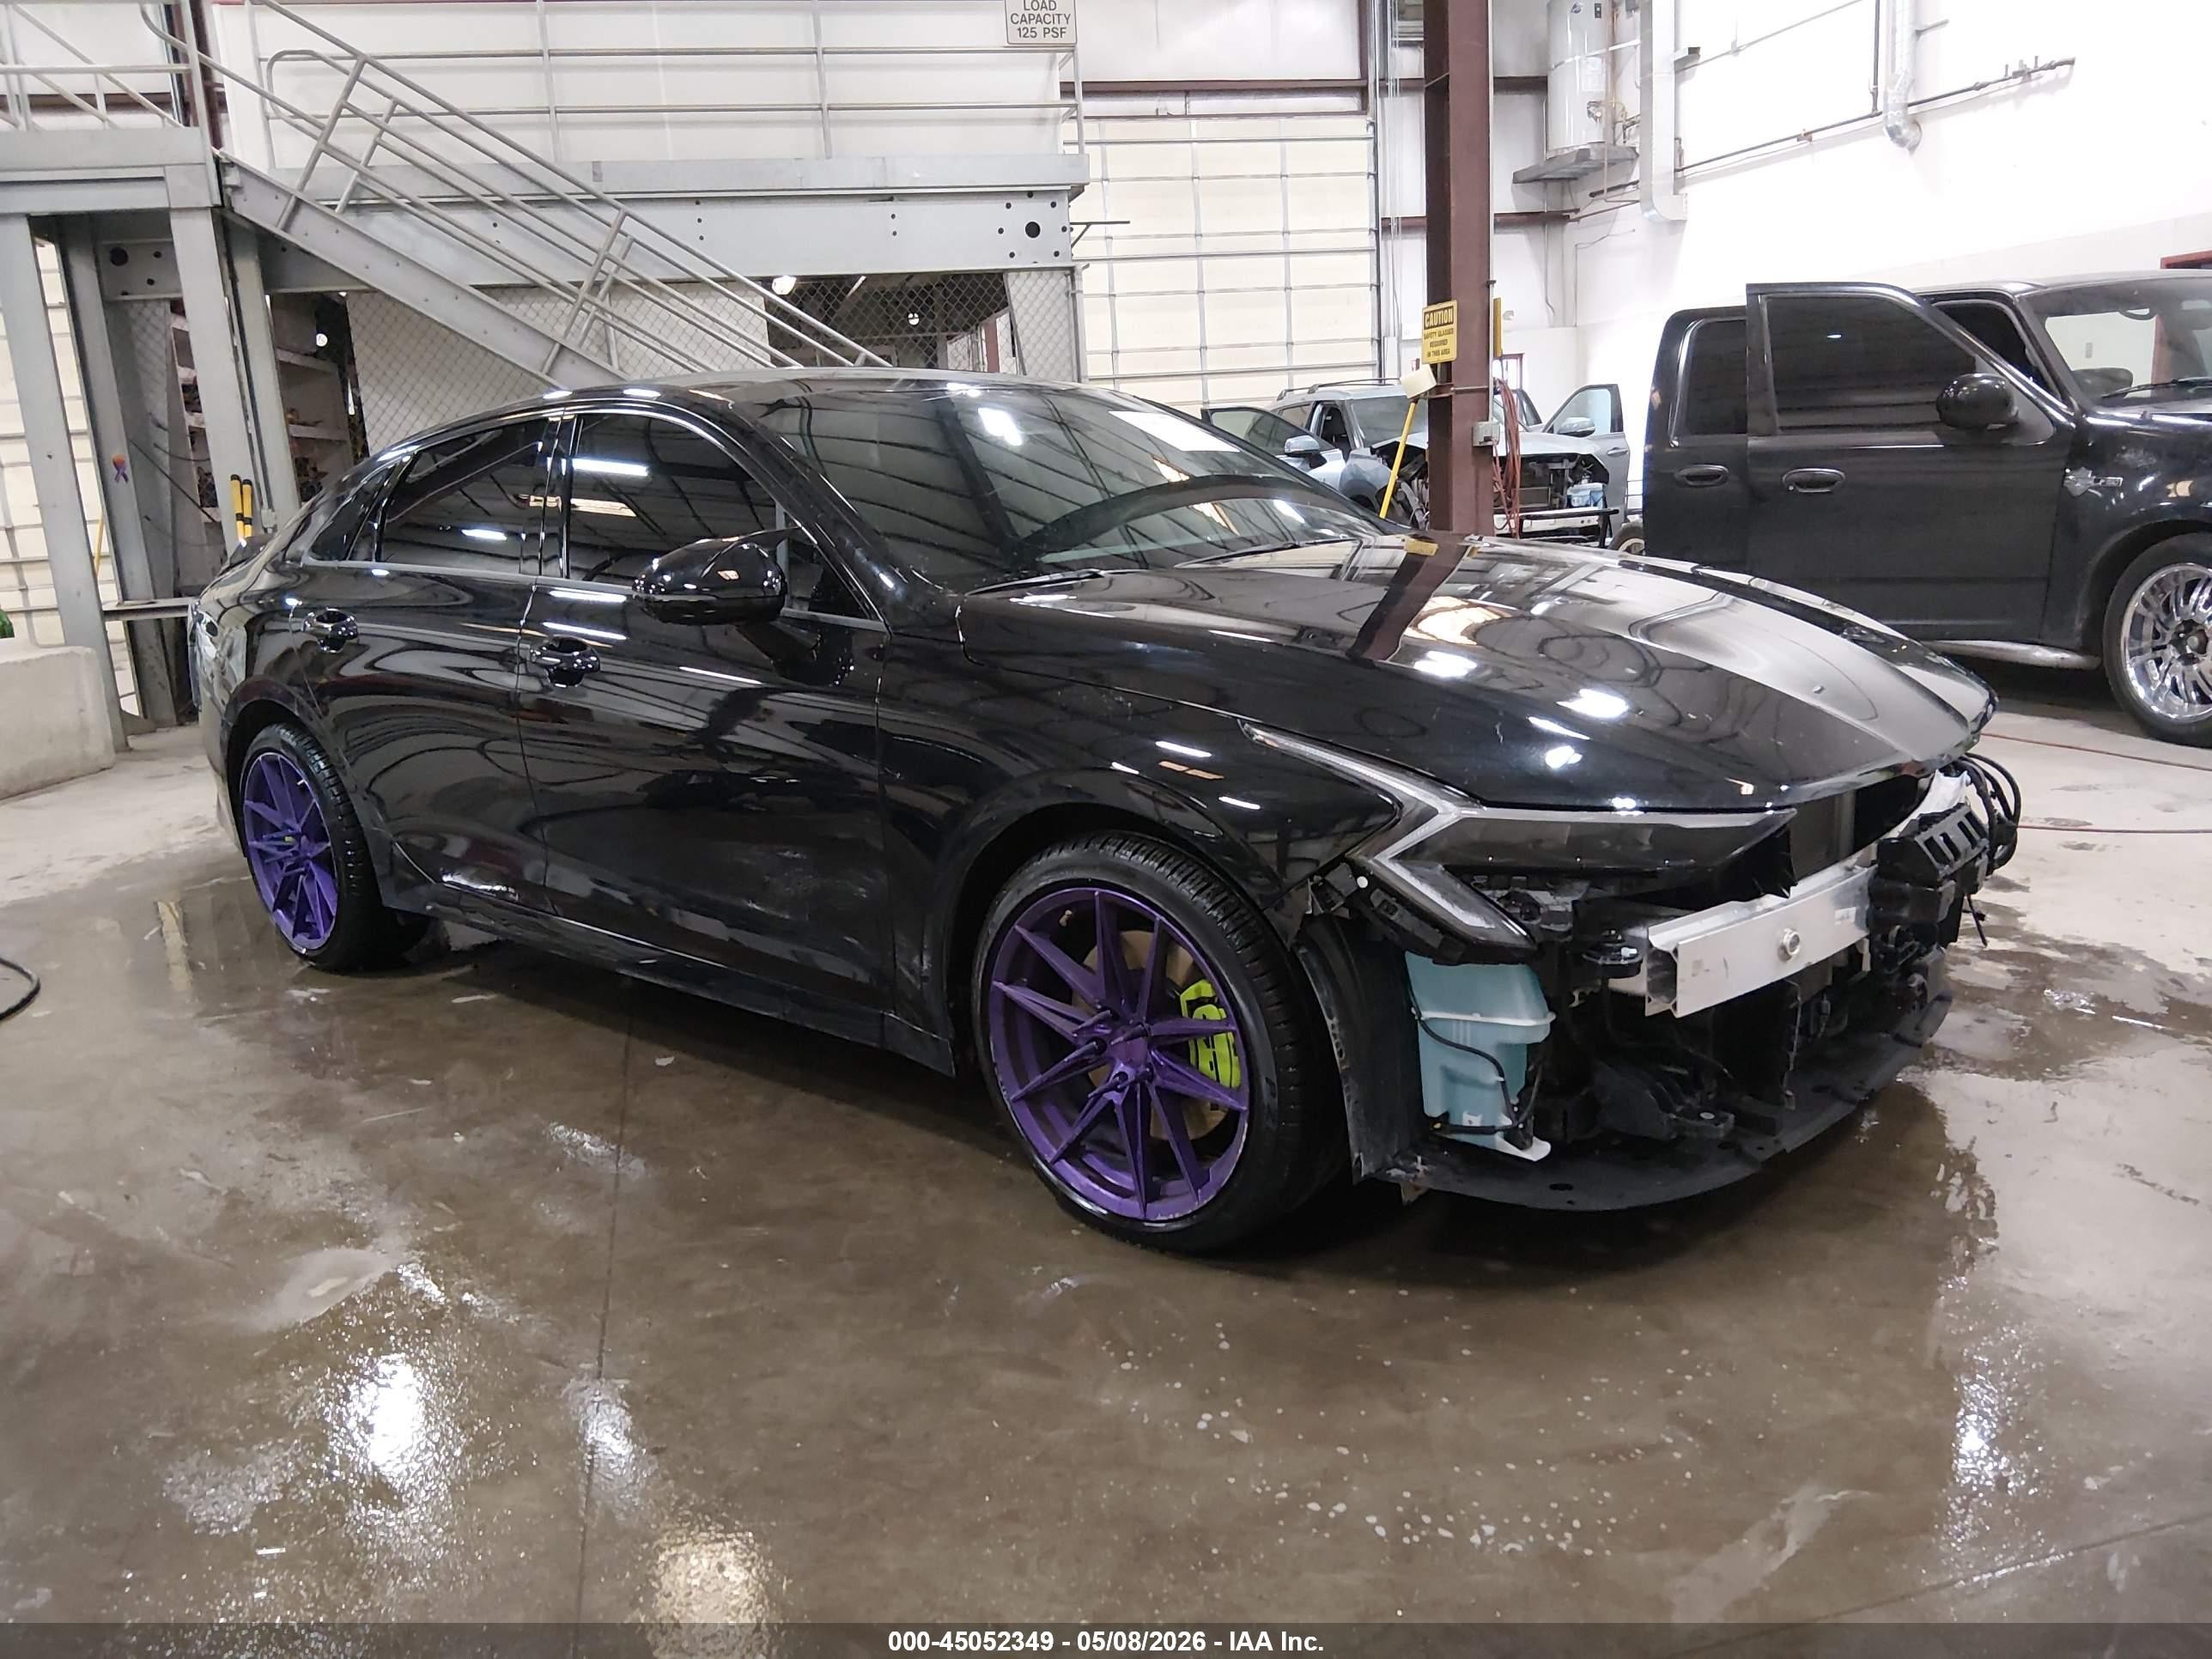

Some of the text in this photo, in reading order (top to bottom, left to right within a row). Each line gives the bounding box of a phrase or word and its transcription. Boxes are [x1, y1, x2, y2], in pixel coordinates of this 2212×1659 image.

[1023, 0, 1057, 11] LOAD
[1010, 13, 1071, 25] CAPACITY
[1017, 27, 1067, 39] 125 PSF
[1425, 308, 1453, 328] CAUTION
